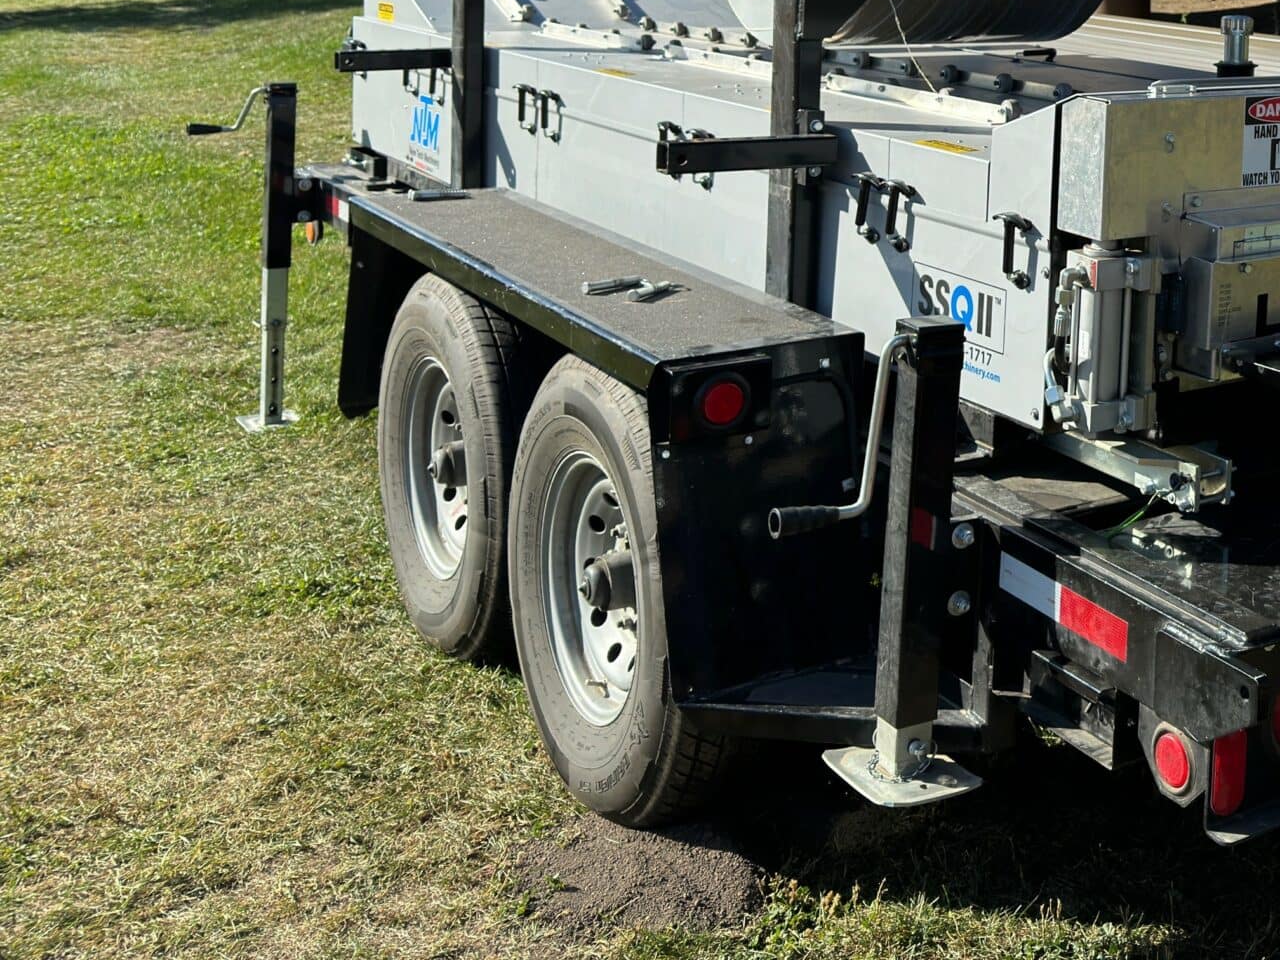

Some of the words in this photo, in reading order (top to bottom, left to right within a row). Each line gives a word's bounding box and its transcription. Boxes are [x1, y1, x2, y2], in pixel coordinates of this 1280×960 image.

[1254, 126, 1278, 139] HAND
[1242, 172, 1268, 187] WATCH
[963, 346, 992, 366] -1717
[963, 361, 1001, 383] hinery.com
